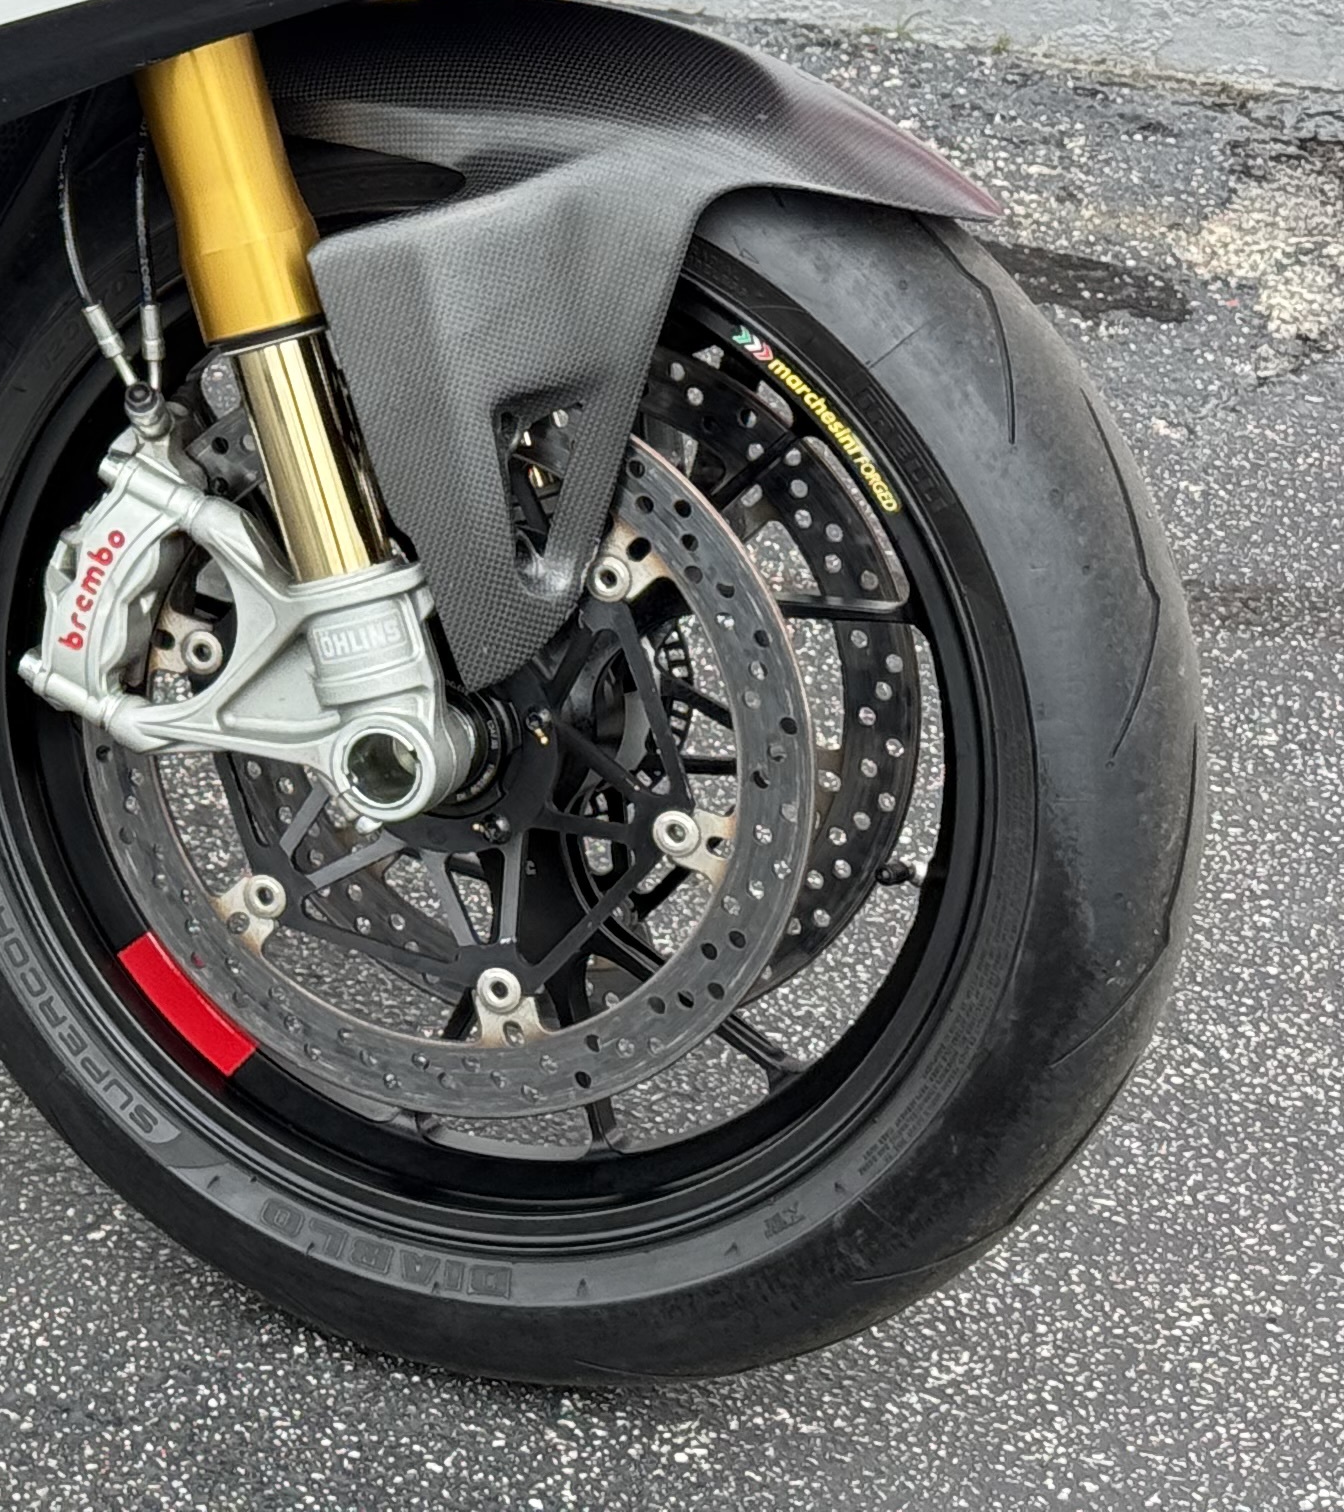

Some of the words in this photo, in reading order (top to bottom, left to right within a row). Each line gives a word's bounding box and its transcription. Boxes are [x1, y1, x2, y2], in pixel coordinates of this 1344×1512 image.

[767, 358, 861, 458] marchesini
[853, 453, 901, 513] FORGED
[58, 530, 126, 651] brembo
[319, 618, 403, 659] ÖHLINS
[261, 1197, 513, 1300] DIABLO
